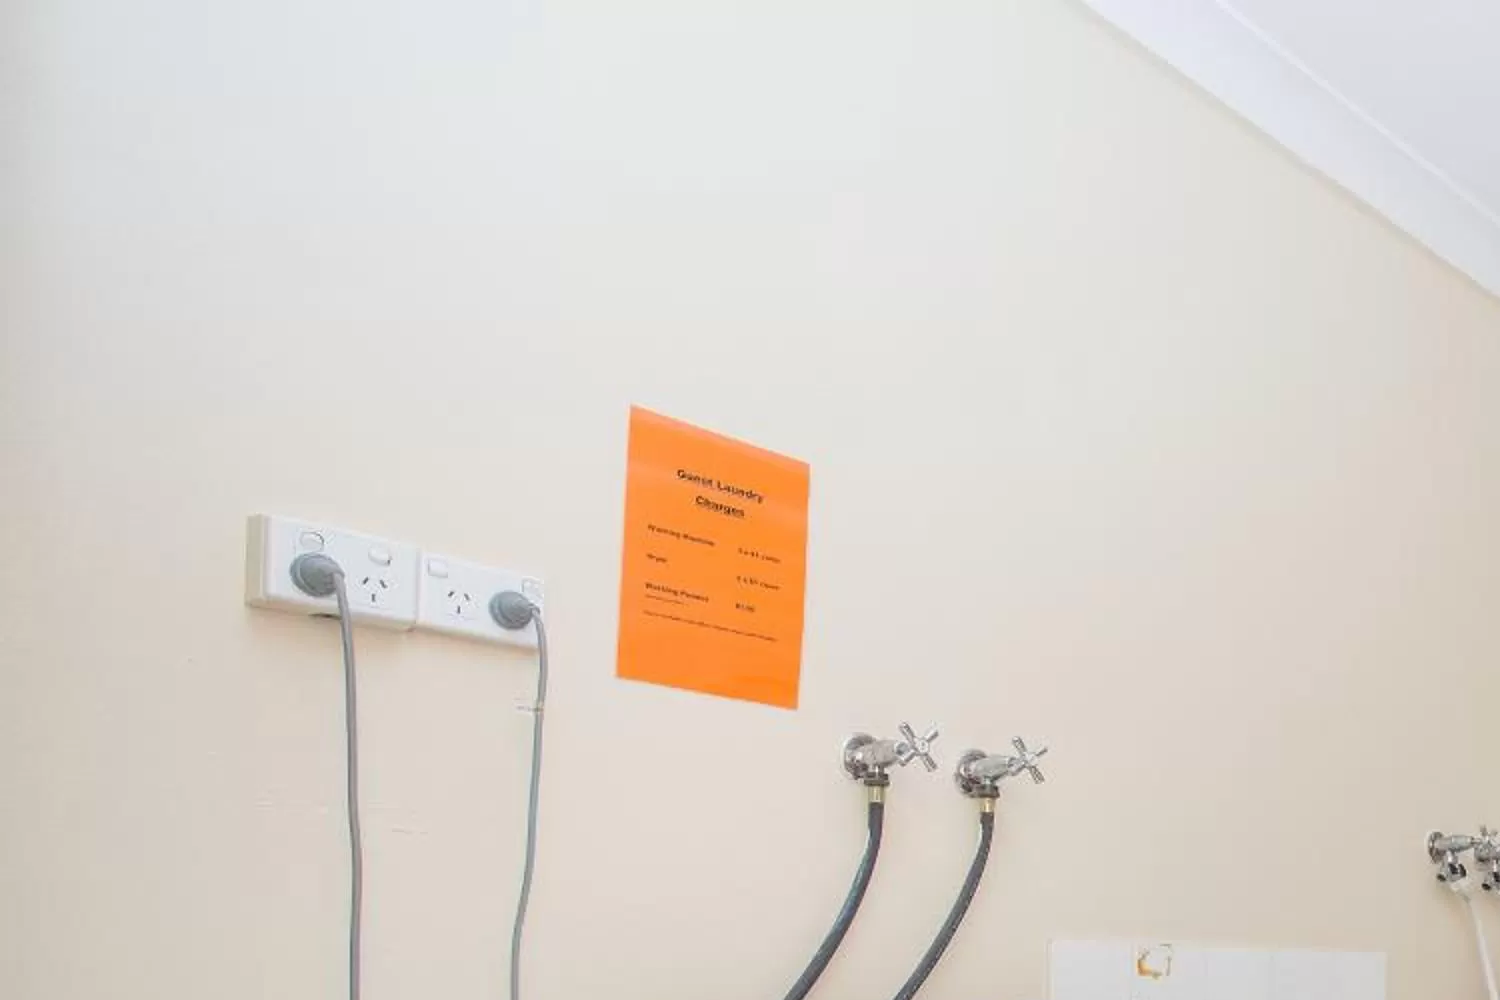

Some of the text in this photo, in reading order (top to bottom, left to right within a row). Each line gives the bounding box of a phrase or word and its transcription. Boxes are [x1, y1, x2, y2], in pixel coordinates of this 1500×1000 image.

[676, 468, 764, 505] Guest Laundry
[695, 495, 745, 518] Charges
